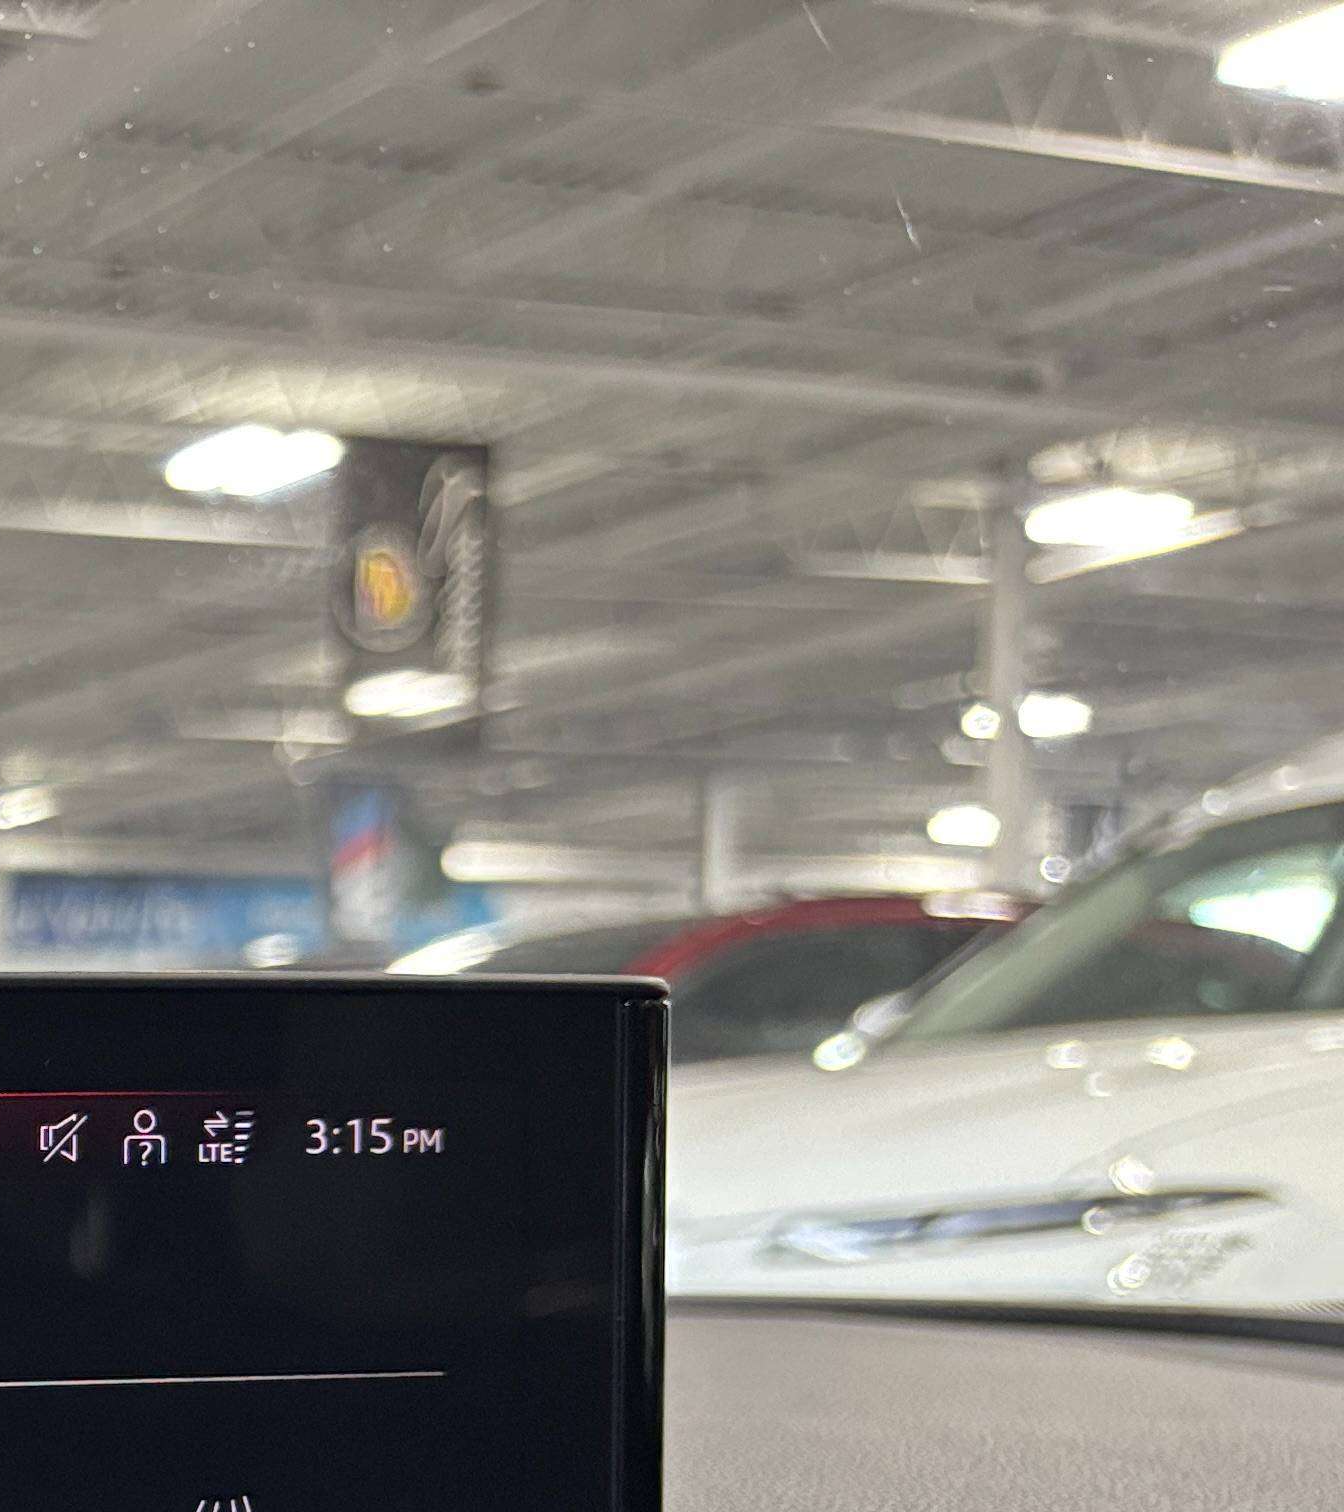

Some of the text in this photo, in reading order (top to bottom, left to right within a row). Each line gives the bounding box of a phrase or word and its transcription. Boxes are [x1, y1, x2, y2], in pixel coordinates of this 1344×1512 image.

[305, 1118, 444, 1156] 3:15 PM
[198, 1142, 234, 1164] LTE
